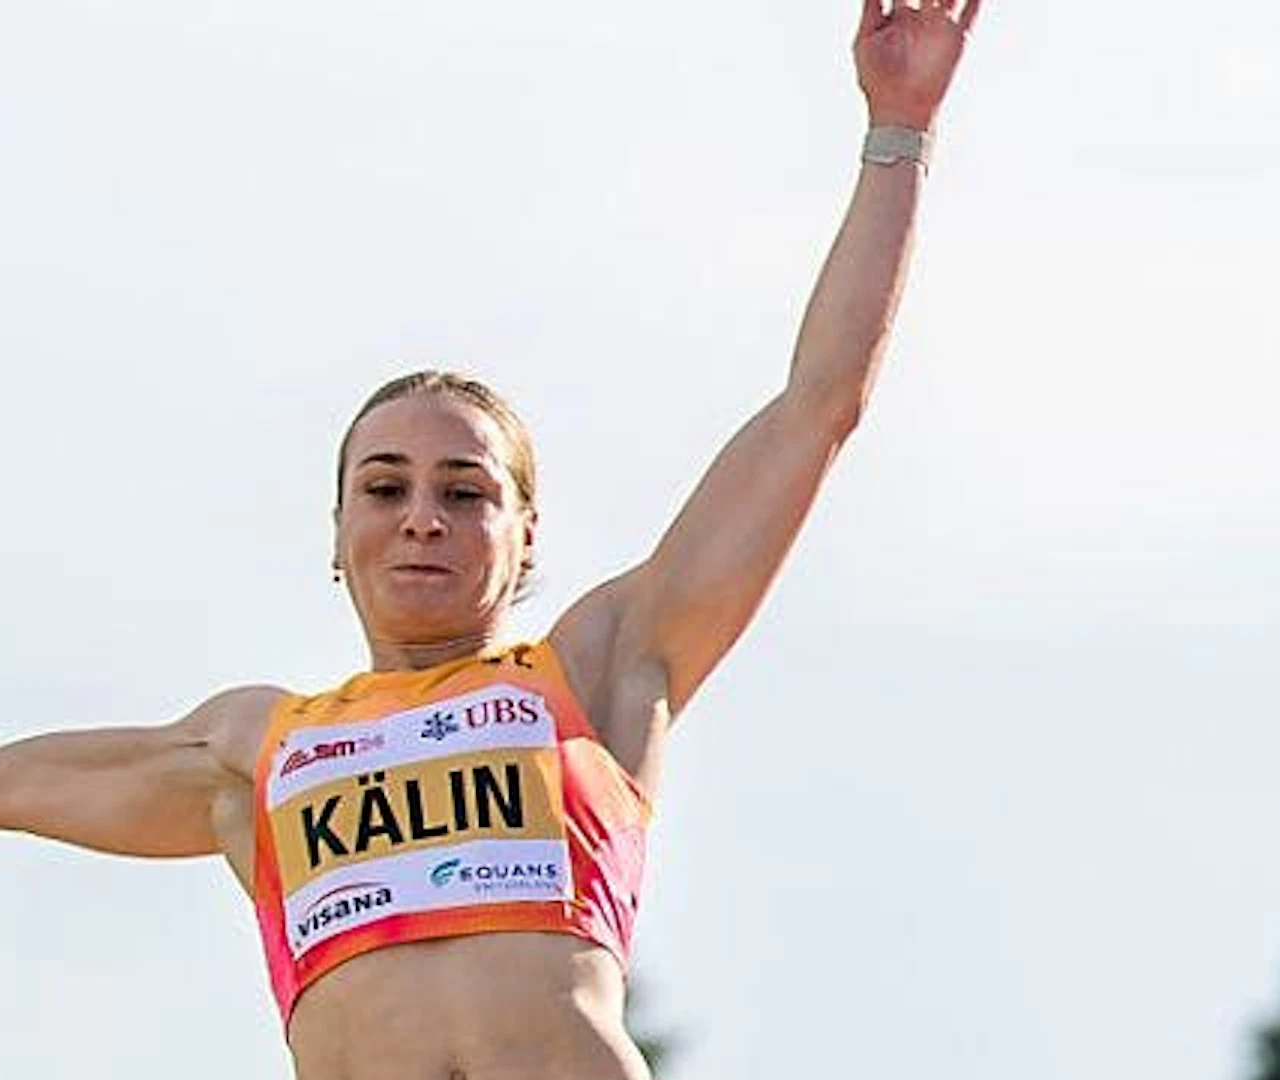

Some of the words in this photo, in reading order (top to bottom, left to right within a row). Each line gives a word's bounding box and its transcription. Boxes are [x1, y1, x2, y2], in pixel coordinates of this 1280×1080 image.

[464, 700, 539, 729] UBS
[301, 764, 524, 868] KÄLIN
[460, 864, 557, 881] EQUANS
